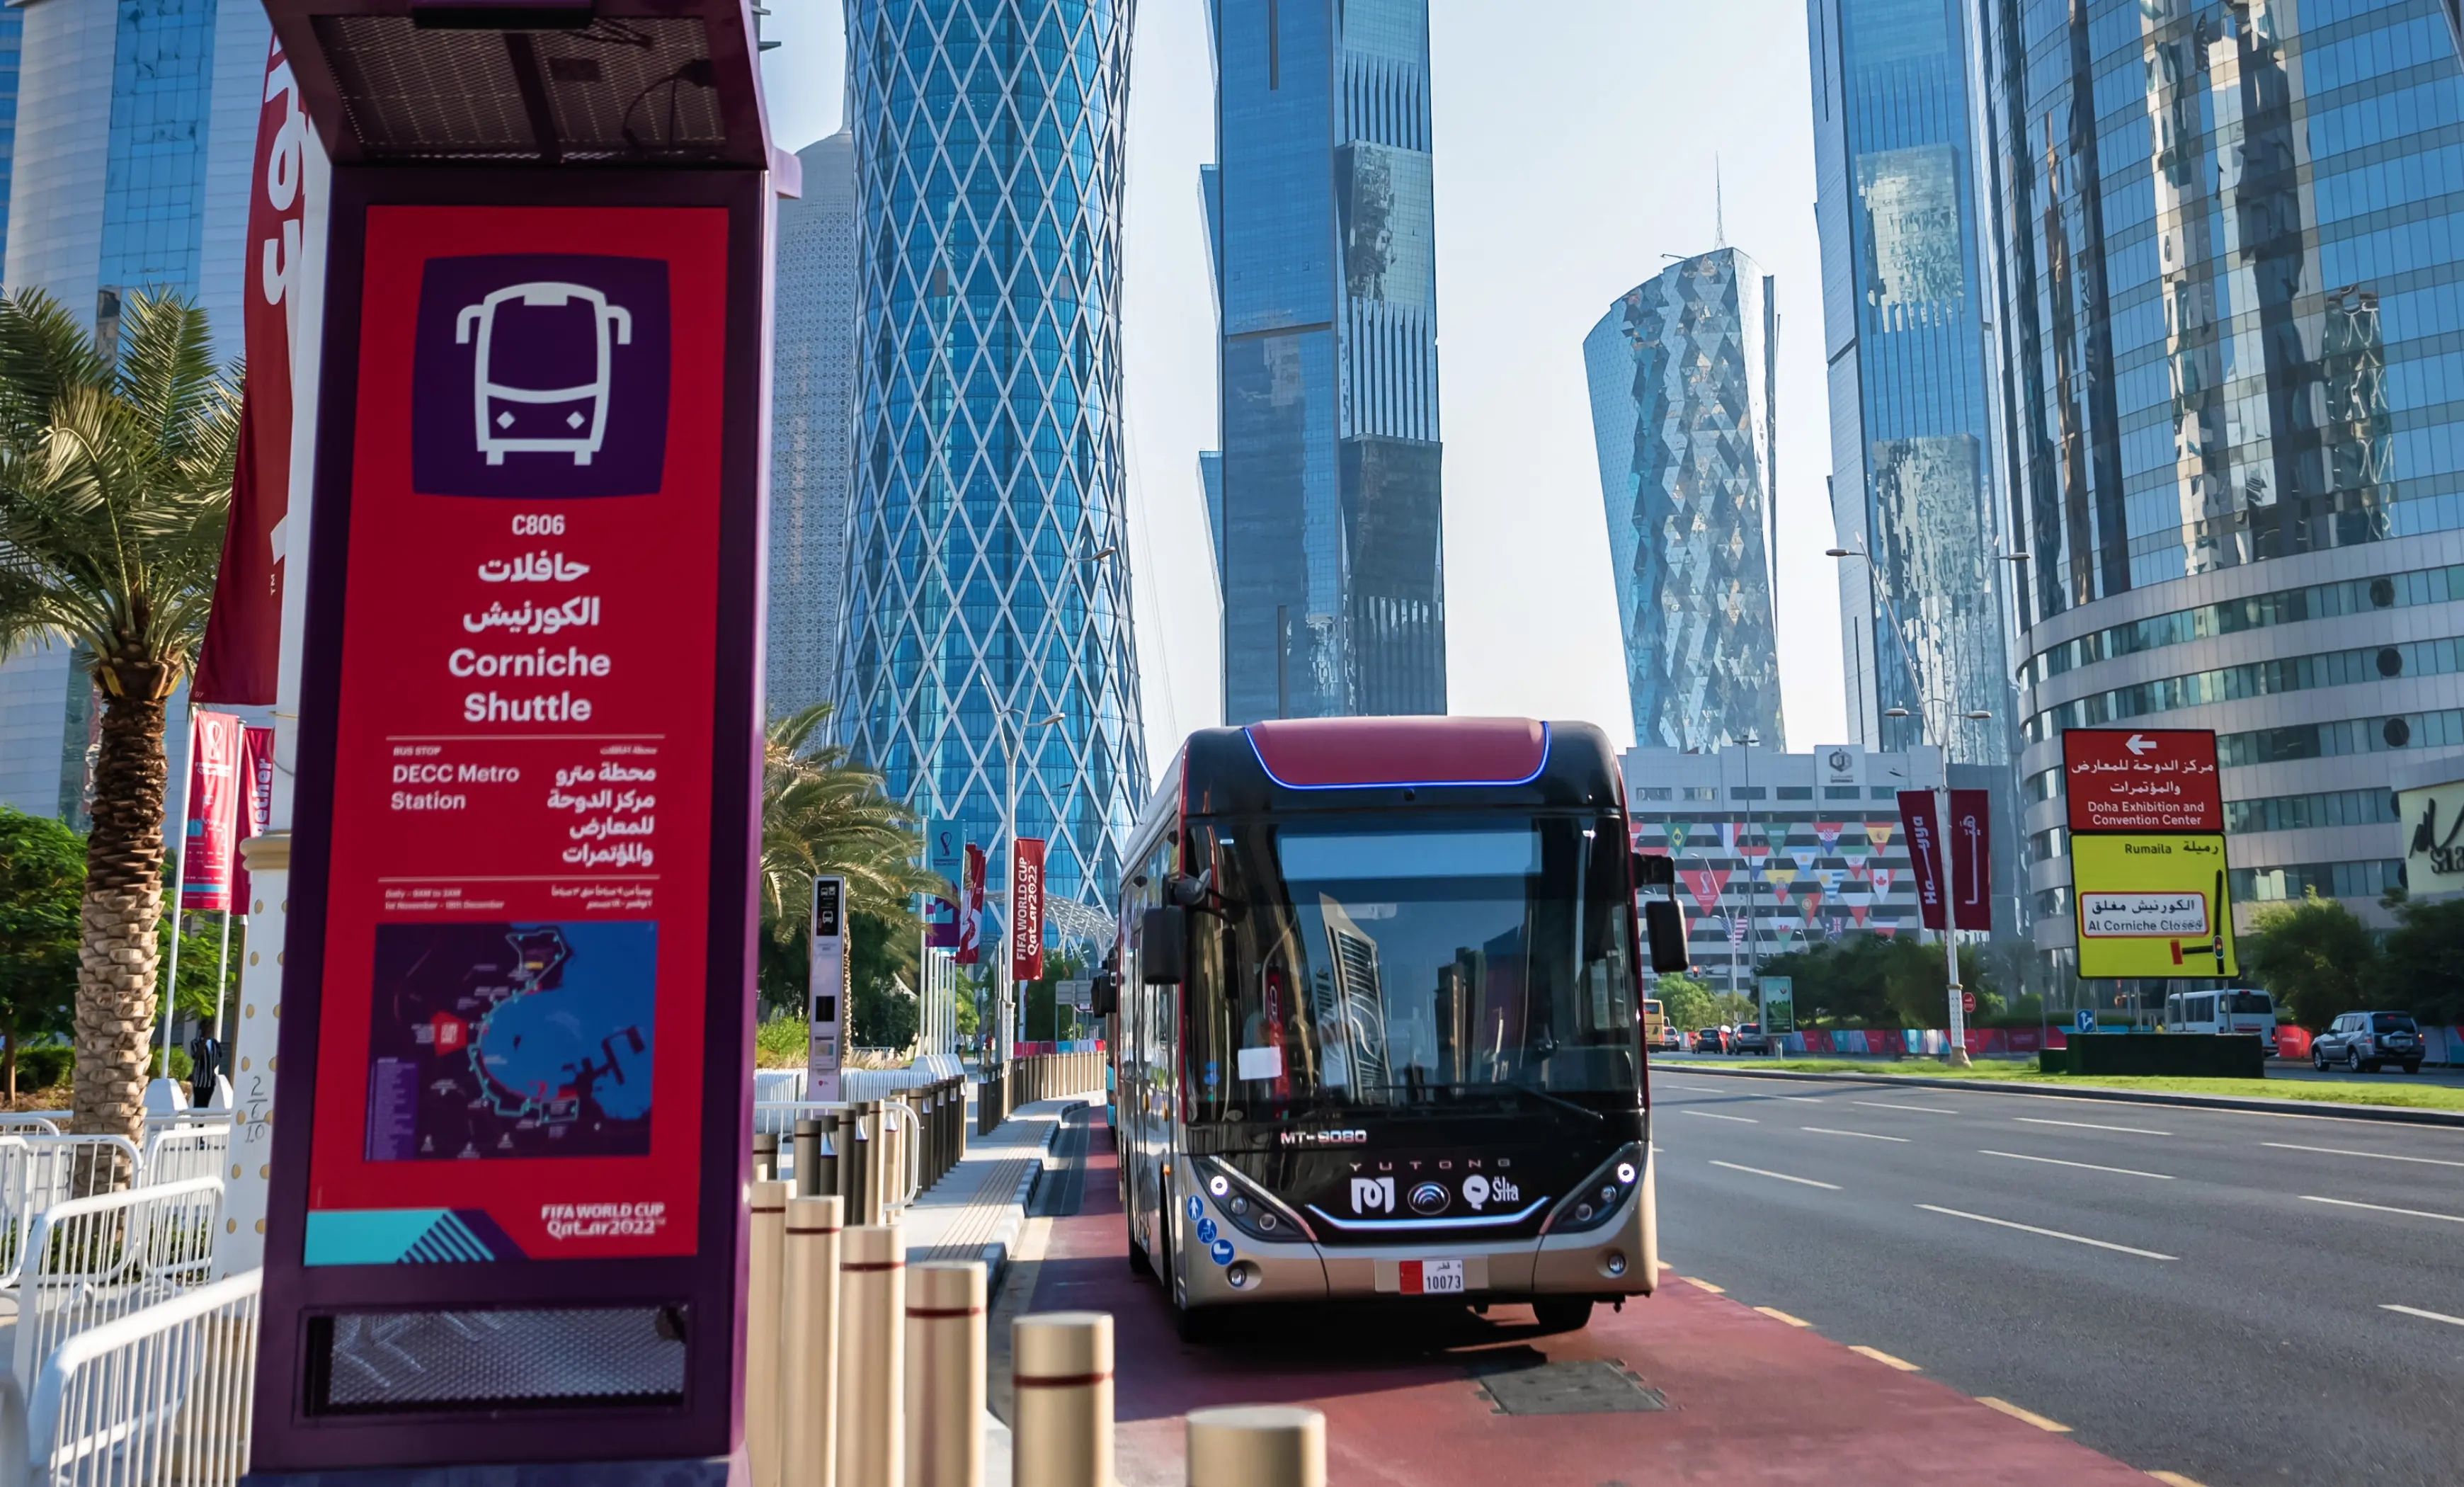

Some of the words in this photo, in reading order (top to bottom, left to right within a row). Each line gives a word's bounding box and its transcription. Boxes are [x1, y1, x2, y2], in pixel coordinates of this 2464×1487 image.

[512, 515, 565, 535] C806
[478, 549, 591, 582] حافلات
[463, 596, 600, 634] الكورنيش
[449, 646, 611, 677] Corniche
[464, 691, 592, 722] Shuttle
[393, 746, 413, 756] BUS
[415, 746, 441, 756] STOP
[393, 764, 453, 783] DECC
[459, 763, 520, 782] Metro
[556, 765, 595, 787] مترو
[598, 761, 656, 782] محطة
[2071, 758, 2128, 774] للمعارض
[2134, 758, 2178, 774] الدوحة
[2181, 759, 2214, 774] مركز
[2110, 781, 2181, 795] والمؤتمرات
[391, 790, 466, 810] Station
[547, 788, 612, 814] الدوحة
[613, 789, 656, 813] مركز
[2088, 802, 2118, 813] Doha
[2122, 802, 2180, 812] Exhibition
[2183, 802, 2204, 812] and
[569, 816, 654, 841] للمعارض
[2092, 815, 2159, 825] Convention
[2162, 815, 2201, 825] Center
[562, 842, 654, 867] والمؤتمرات
[2125, 843, 2172, 854] Rumaila
[2183, 841, 2220, 855] رميلة
[1019, 857, 1029, 883] CUP
[1017, 885, 1027, 930] WORLD
[1027, 865, 1038, 955] Qatar2022
[2092, 899, 2126, 915] مغلق
[2132, 899, 2195, 914] الكورنيش
[2089, 921, 2102, 931] Al
[2105, 920, 2157, 931] Corniche
[2160, 917, 2203, 931] Closed
[1017, 933, 1026, 960] FIFA
[251, 1076, 265, 1098] 2
[245, 1124, 265, 1143] 10
[1281, 1130, 1367, 1144] MT-9080
[1350, 1158, 1511, 1172] YUTONG
[541, 1204, 574, 1219] FIFA
[576, 1203, 632, 1219] WORLD
[634, 1202, 665, 1217] CUP
[1426, 1275, 1461, 1290] 10073
